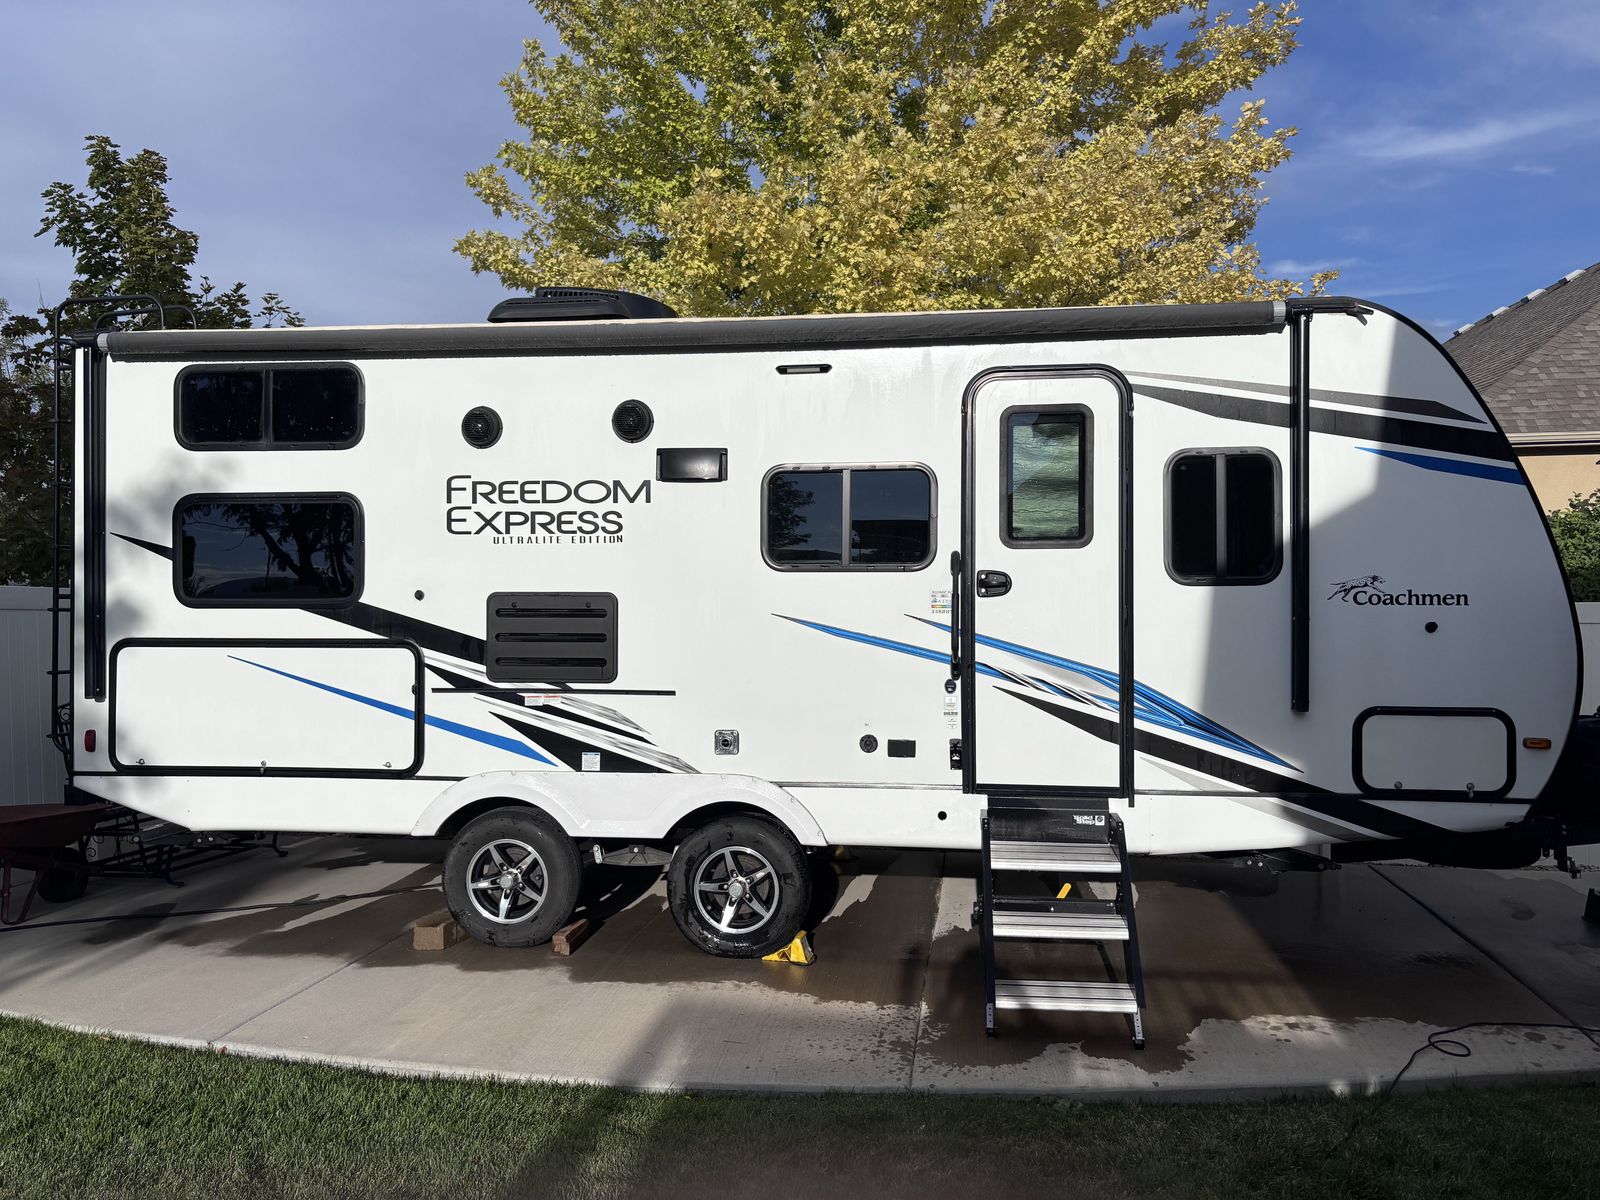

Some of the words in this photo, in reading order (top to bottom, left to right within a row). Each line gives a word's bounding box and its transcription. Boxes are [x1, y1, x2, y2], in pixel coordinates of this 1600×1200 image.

[446, 475, 651, 504] FREEDOM
[446, 506, 623, 535] EXPRESS
[493, 535, 562, 545] ULTRALITE
[571, 534, 624, 544] EDITION
[1352, 589, 1470, 606] Coachmen
